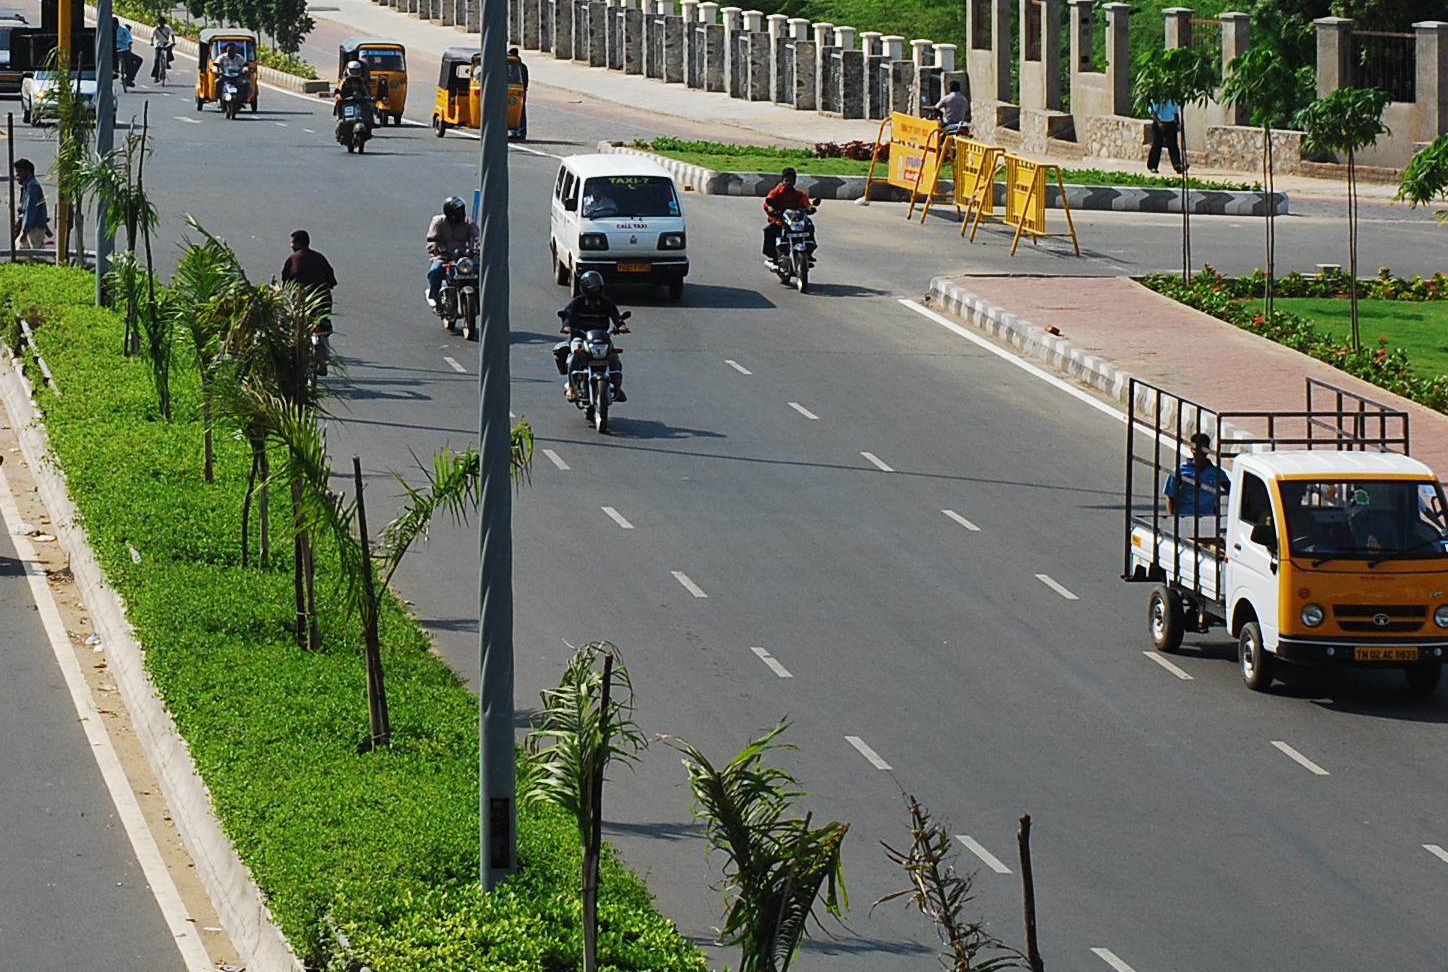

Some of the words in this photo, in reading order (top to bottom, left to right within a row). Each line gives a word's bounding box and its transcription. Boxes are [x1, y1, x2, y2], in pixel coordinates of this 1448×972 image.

[1356, 650, 1369, 659] TN
[1369, 650, 1381, 659] 02
[1382, 650, 1394, 659] AC
